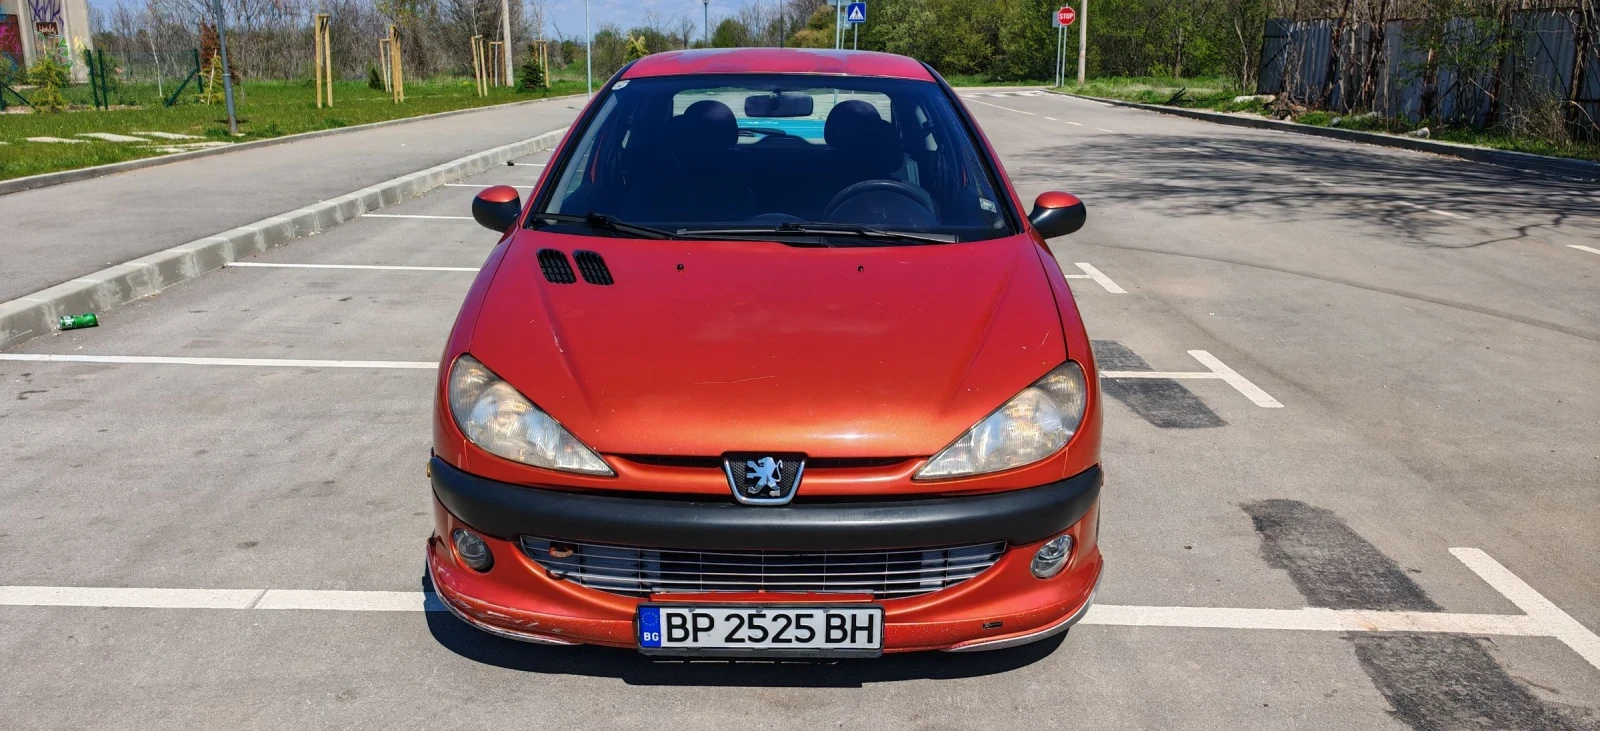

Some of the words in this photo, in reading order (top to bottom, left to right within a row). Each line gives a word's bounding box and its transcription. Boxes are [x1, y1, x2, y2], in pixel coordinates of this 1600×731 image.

[643, 631, 660, 642] BG
[666, 612, 715, 643] BP
[724, 613, 816, 644] 2525
[825, 613, 874, 644] BH
